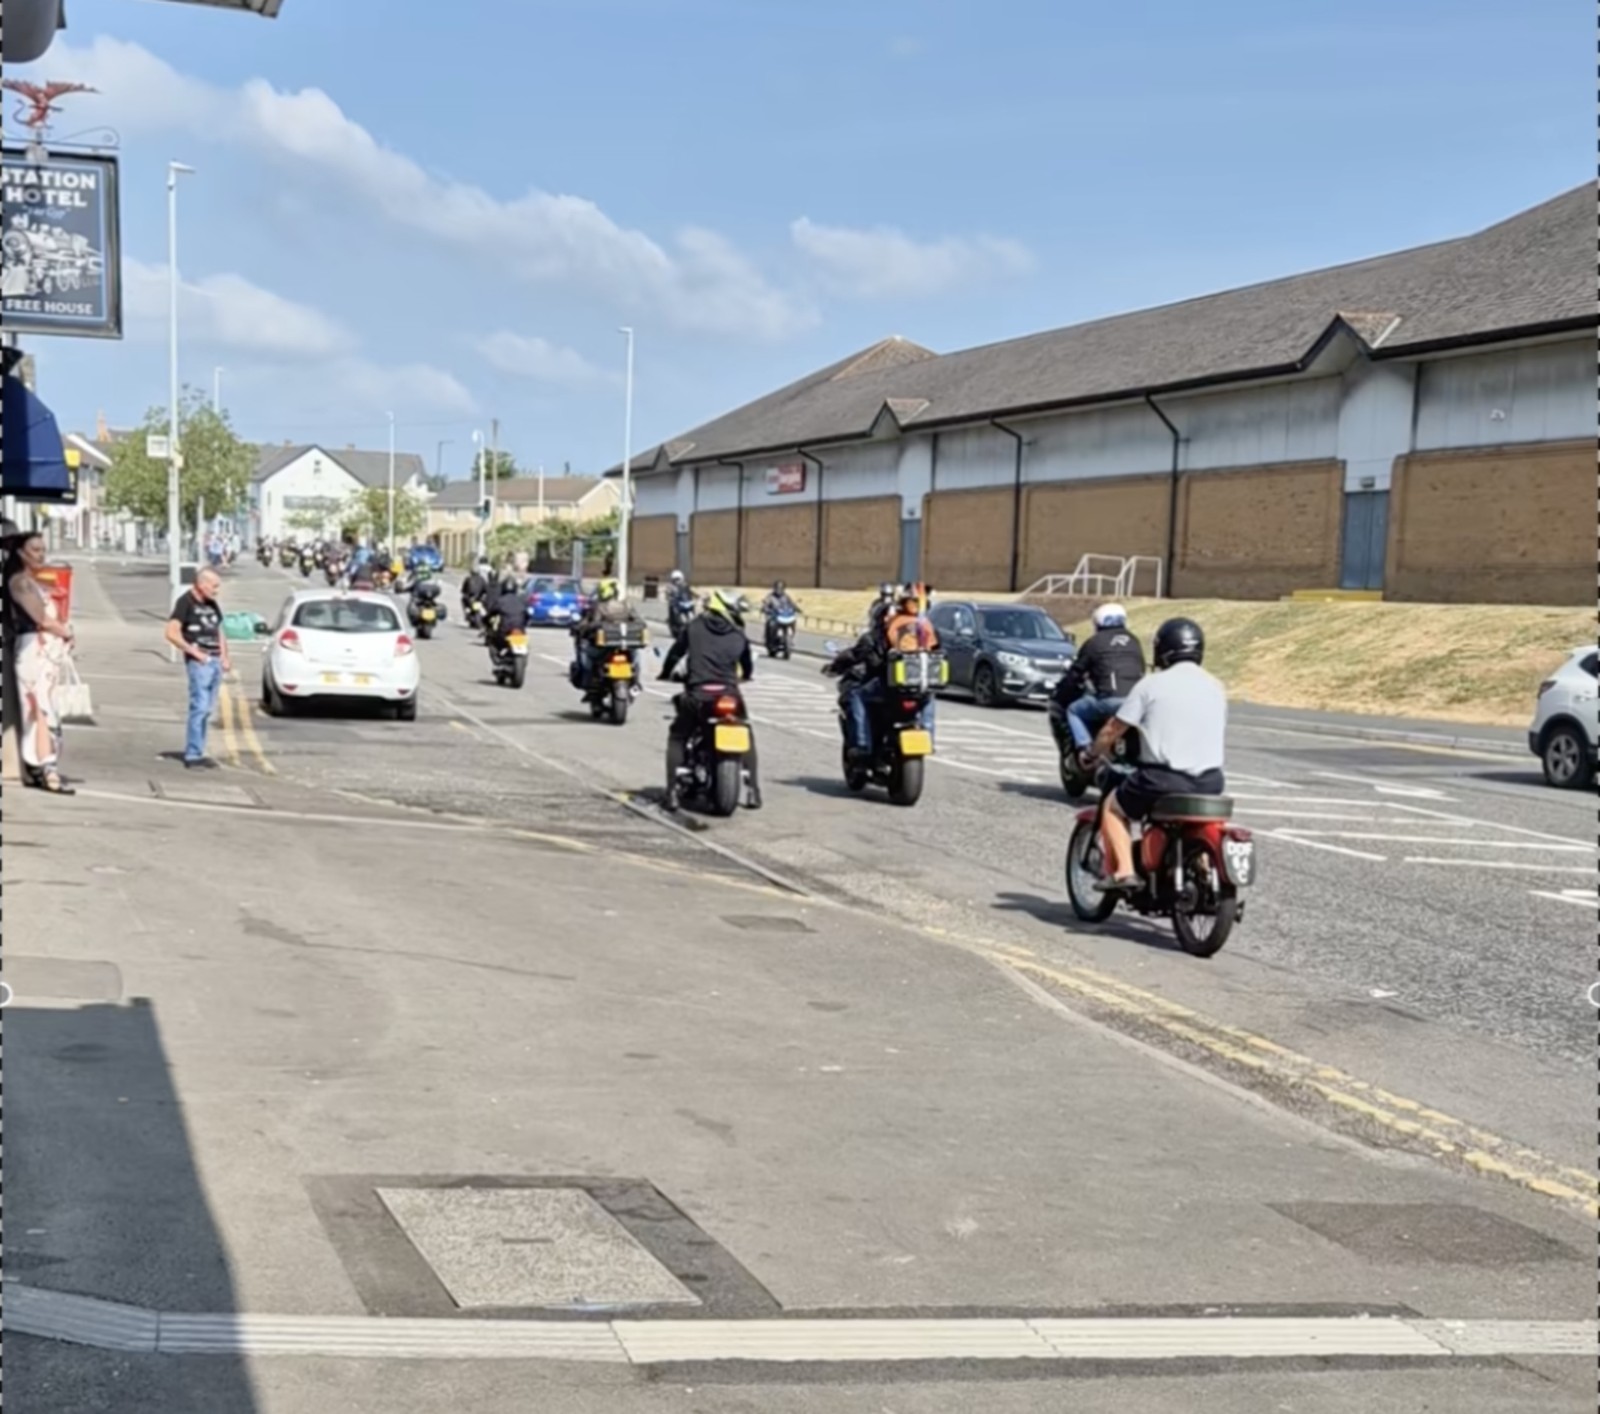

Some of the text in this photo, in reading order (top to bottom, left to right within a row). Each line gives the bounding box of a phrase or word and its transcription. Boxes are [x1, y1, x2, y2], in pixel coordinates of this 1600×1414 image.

[6, 186, 88, 207] HOTEL
[6, 299, 93, 315] FREE HOUSE
